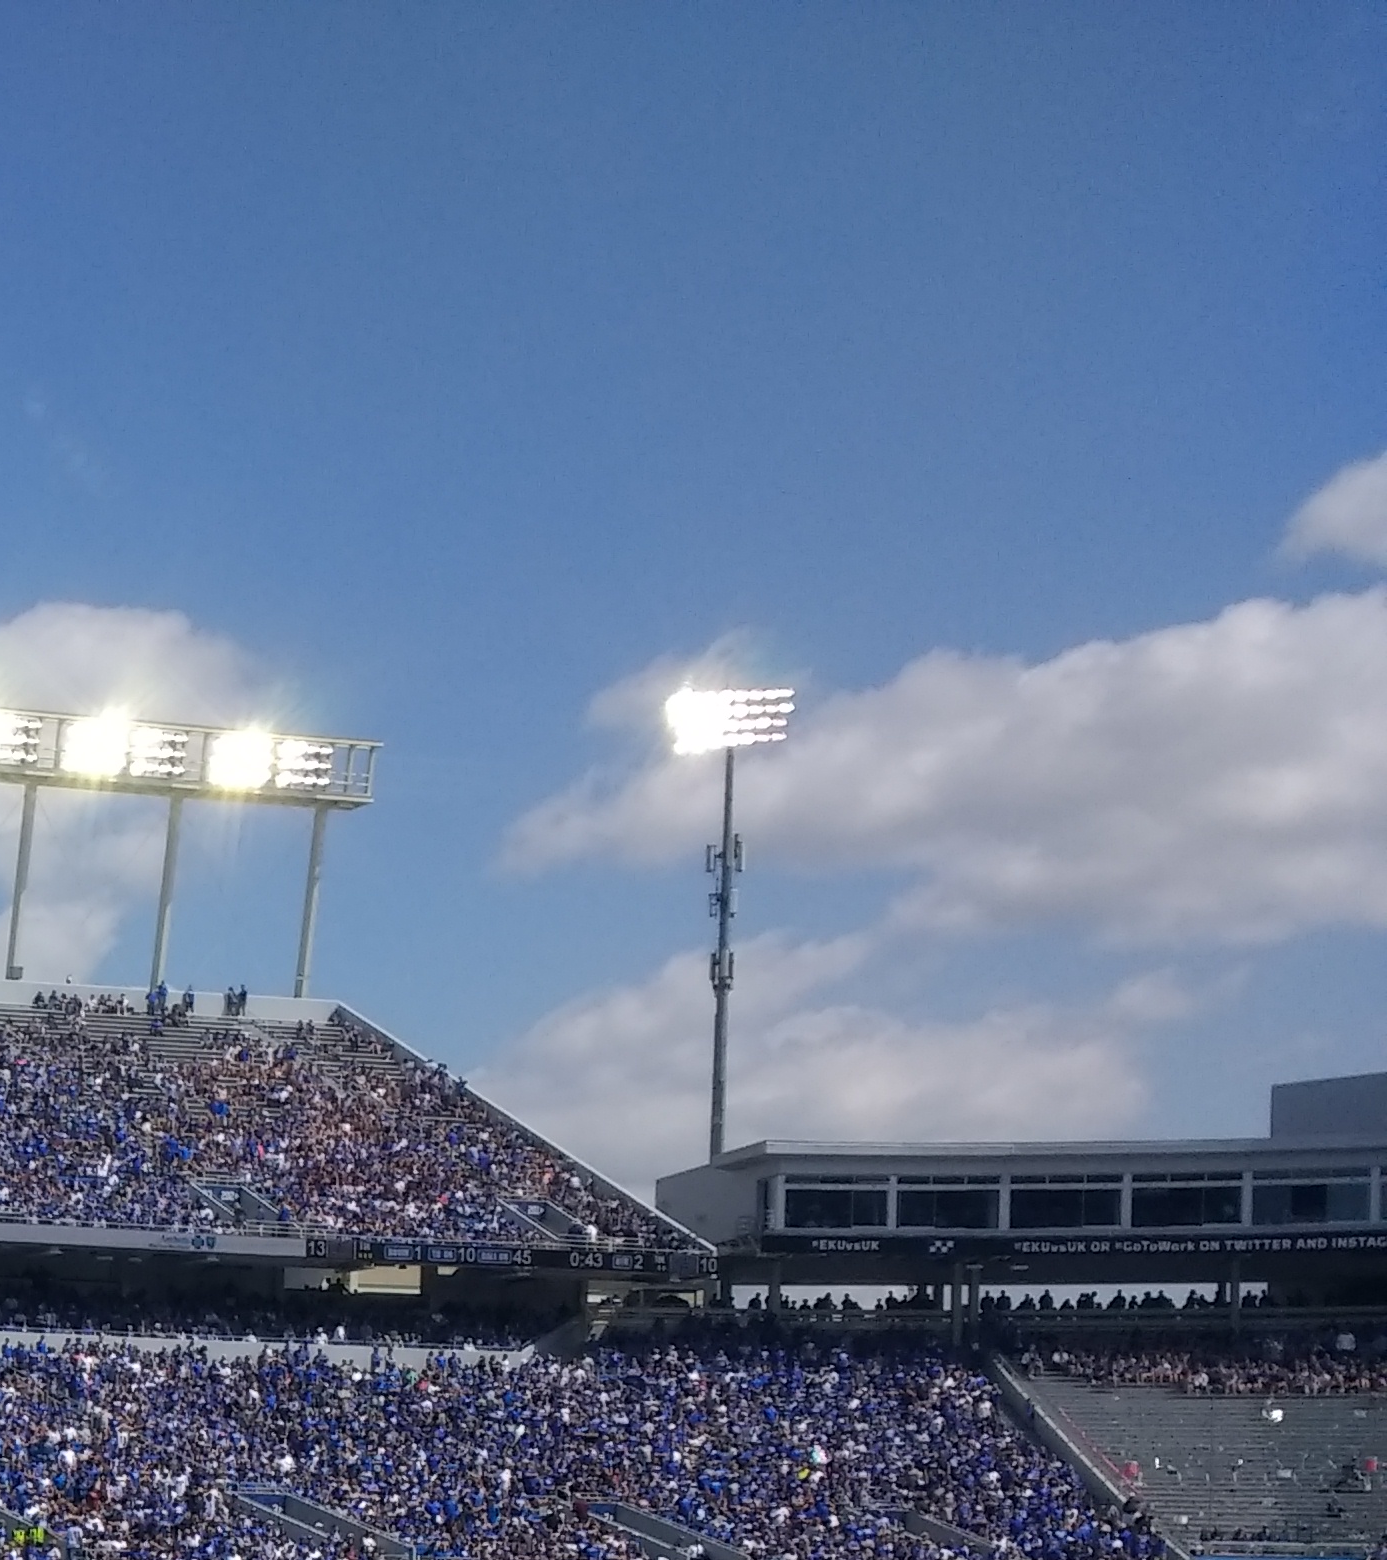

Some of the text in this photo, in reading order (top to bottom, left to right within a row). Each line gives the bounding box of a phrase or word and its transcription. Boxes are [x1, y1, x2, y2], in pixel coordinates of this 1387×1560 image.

[308, 1240, 326, 1257] 13
[414, 1246, 422, 1260] 1
[458, 1247, 476, 1262] 10
[513, 1250, 532, 1265] 45
[1090, 1240, 1110, 1252] OR
[1199, 1240, 1220, 1251] ON
[1225, 1238, 1291, 1250] TWITTER
[1296, 1237, 1327, 1249] AND
[569, 1252, 604, 1268] 0:43
[633, 1255, 644, 1269] 2
[700, 1258, 718, 1273] 10
